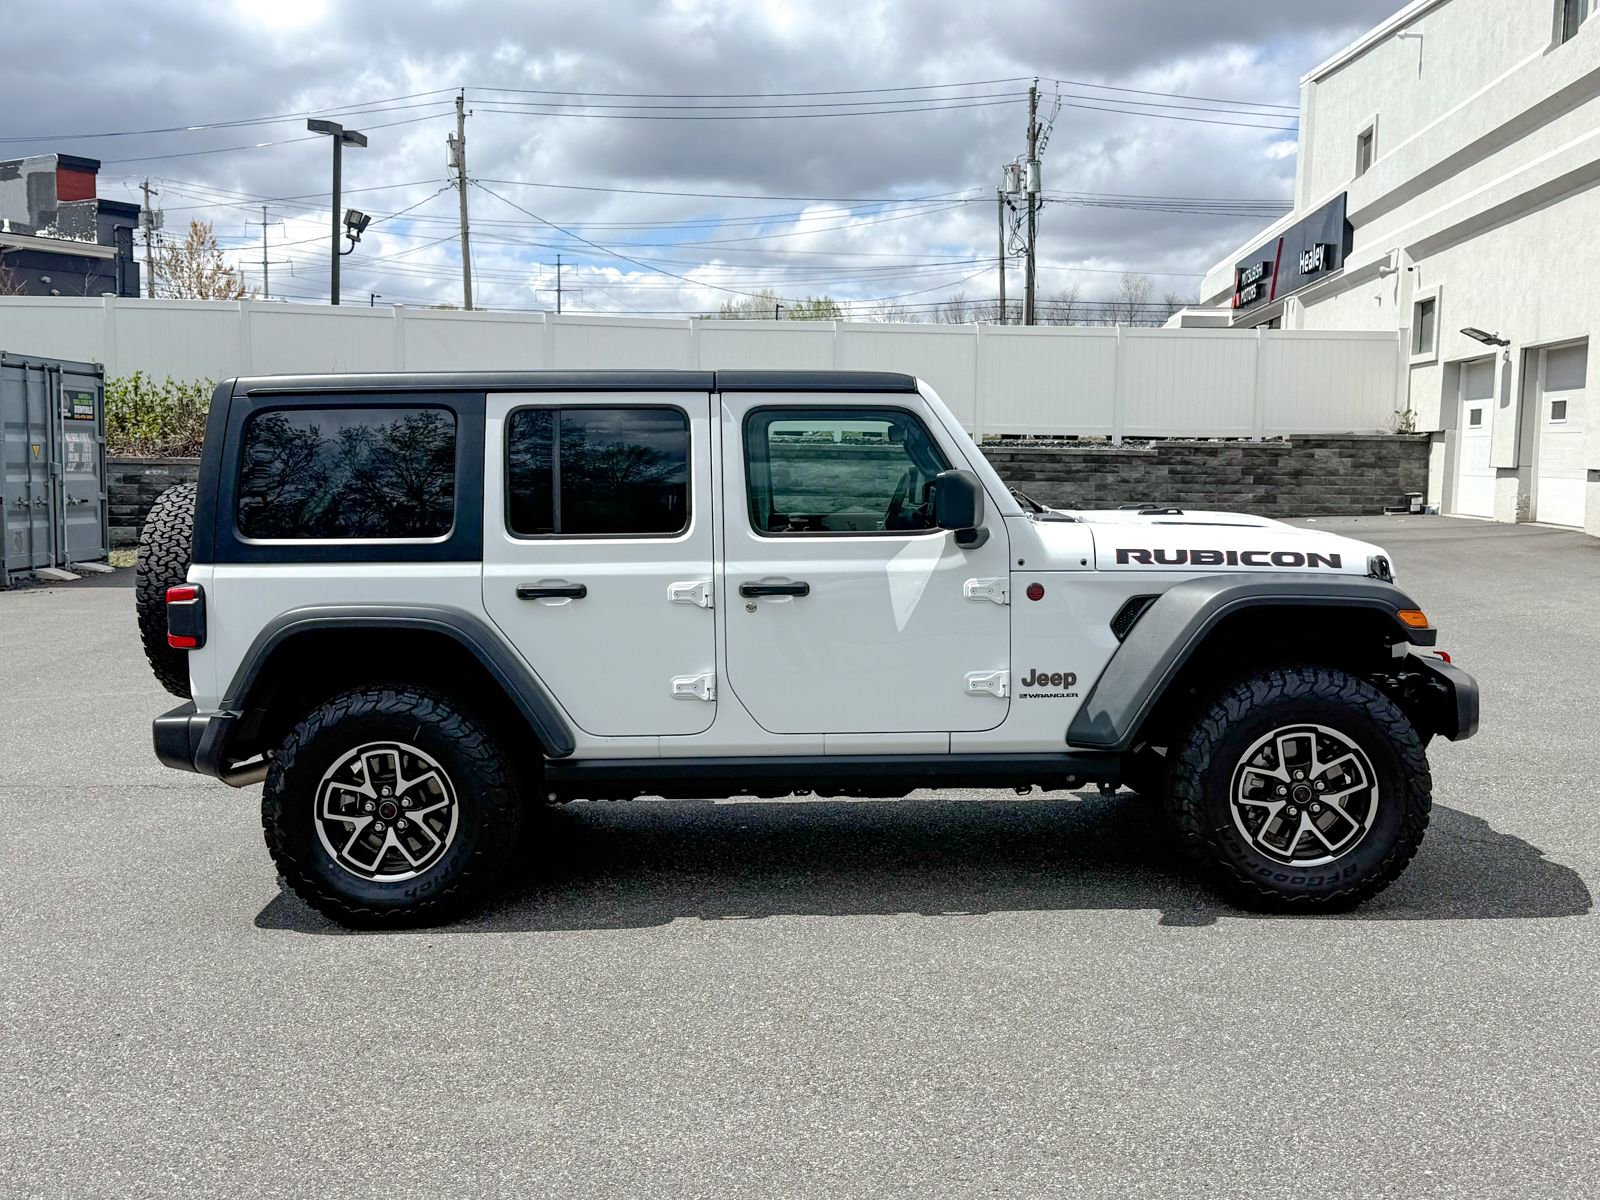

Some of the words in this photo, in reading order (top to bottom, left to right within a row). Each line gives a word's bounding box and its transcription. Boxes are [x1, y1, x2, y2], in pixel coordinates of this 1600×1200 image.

[1299, 243, 1325, 275] Healey
[1115, 548, 1343, 569] RUBICON
[1021, 668, 1077, 690] Jeep
